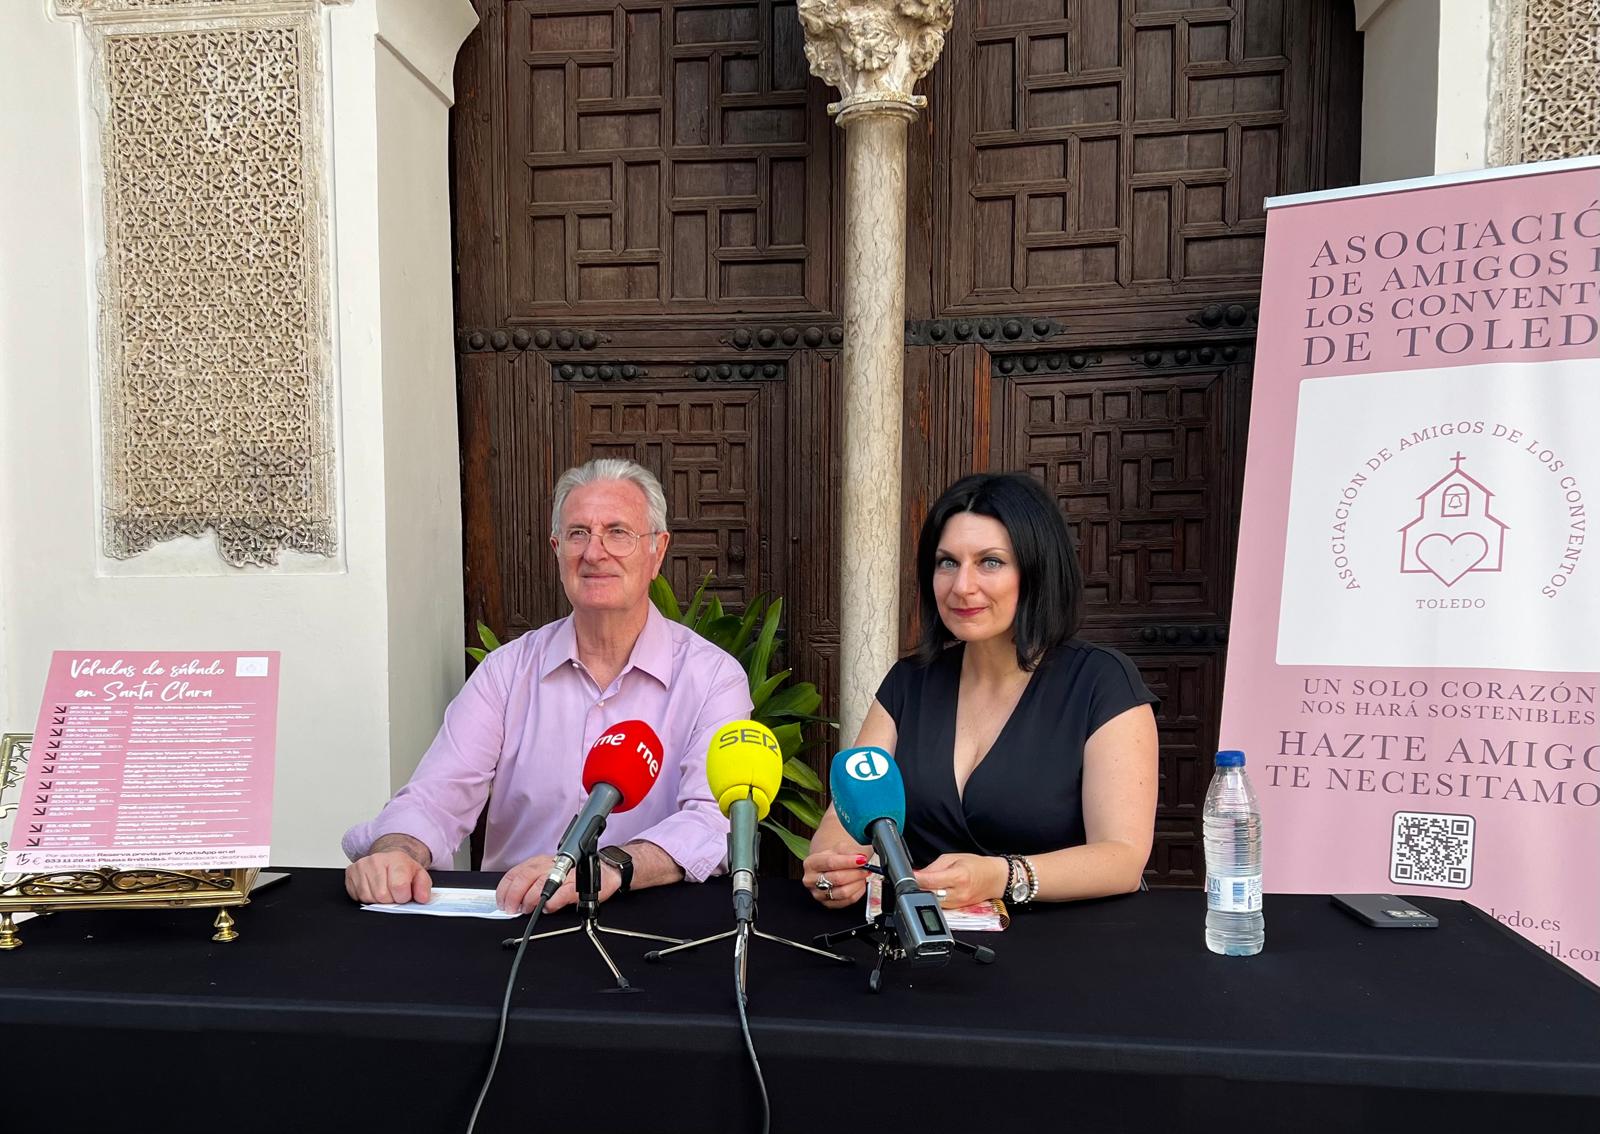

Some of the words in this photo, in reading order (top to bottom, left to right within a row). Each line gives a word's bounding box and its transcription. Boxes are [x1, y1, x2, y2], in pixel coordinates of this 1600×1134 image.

[1307, 271, 1363, 299] DE
[1380, 250, 1568, 292] AMIGOS
[1305, 301, 1374, 328] LOS
[1391, 281, 1600, 320] CONVENT
[1301, 332, 1372, 366] DE
[1397, 313, 1600, 358] TOLED
[1398, 421, 1485, 451] AMIGOS
[1492, 423, 1523, 443] DE
[1366, 448, 1393, 471] DE
[1525, 440, 1564, 473] LOS
[1332, 472, 1367, 591] ASOCIACIÓN
[1541, 476, 1586, 599] CONVENTOS
[1416, 598, 1486, 609] TOLEDO
[70, 658, 136, 678] Veladas
[143, 659, 164, 676] de
[170, 658, 225, 678] sábado
[75, 689, 97, 698] en
[103, 681, 158, 701] Santa
[160, 681, 213, 701] Clara
[1303, 678, 1342, 695] UN
[1352, 679, 1428, 698] SOLO
[1440, 681, 1596, 704] CORAZÓN
[1300, 700, 1345, 715] NOS
[1354, 699, 1418, 717] HARÁ
[1428, 704, 1595, 725] SOSTENIBLES
[636, 741, 659, 777] rne
[1277, 730, 1427, 762] HAZTE
[854, 751, 881, 779] d
[1265, 765, 1310, 788] TE
[1327, 768, 1600, 806] NECESITAMO
